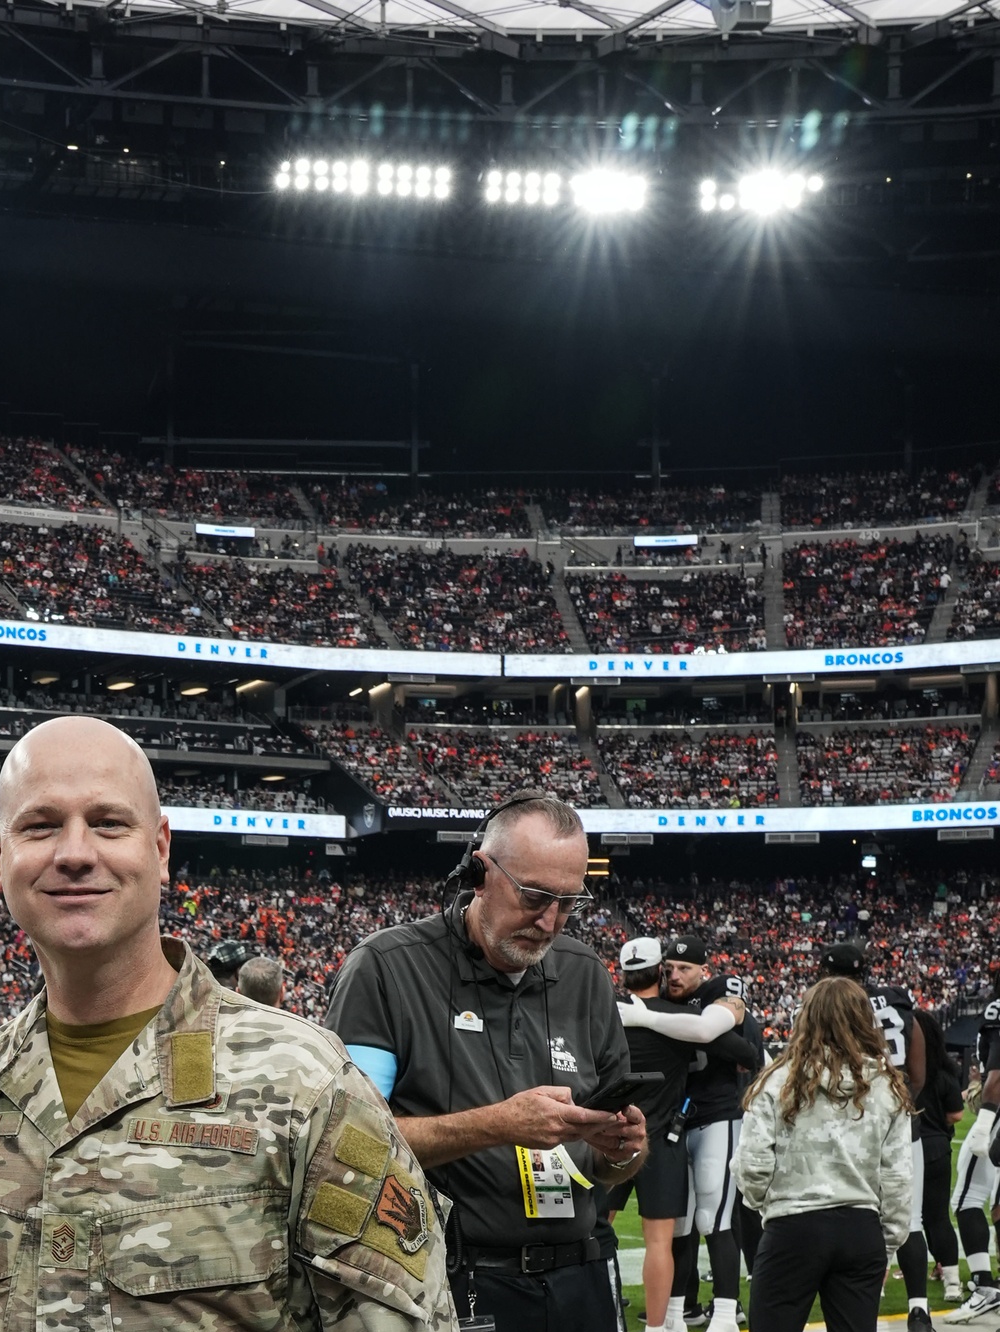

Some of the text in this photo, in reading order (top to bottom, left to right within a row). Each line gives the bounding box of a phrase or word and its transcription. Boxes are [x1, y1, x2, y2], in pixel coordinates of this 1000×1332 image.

[859, 530, 880, 540] 420
[177, 641, 268, 659] DENVER
[588, 660, 687, 671] DENVER
[824, 651, 904, 666] BRONCOS
[388, 807, 421, 818] (MUSIC)
[422, 808, 449, 818] MUSIC
[449, 808, 484, 818] PLAYING
[912, 806, 998, 823] BRONCOS
[213, 815, 306, 830] DENVER
[658, 815, 765, 826] DENVER
[984, 999, 1000, 1020] 6
[134, 1120, 254, 1150] U.S. AIR FORCE
[520, 1147, 534, 1215] GAME SERVICES
